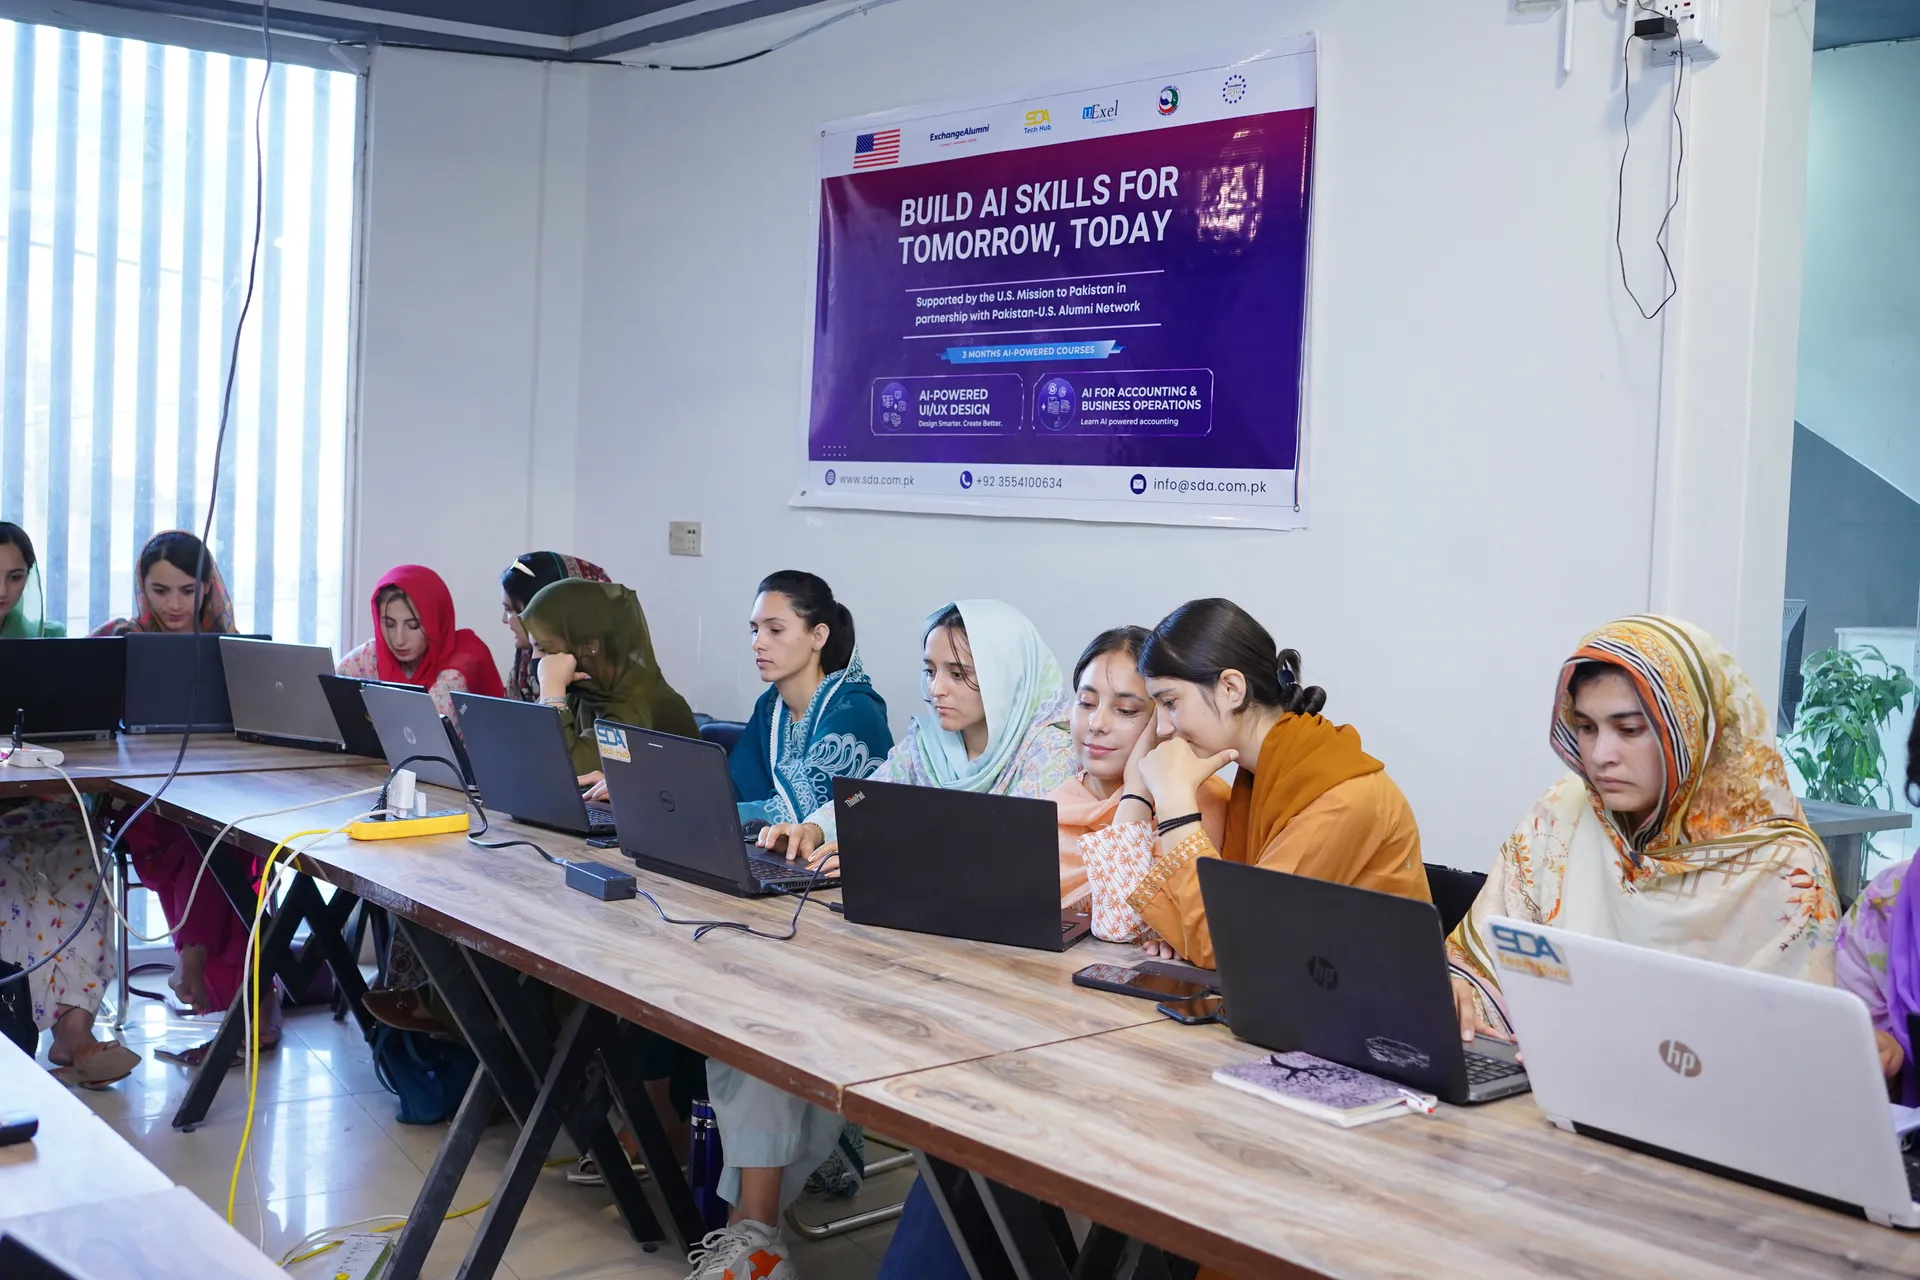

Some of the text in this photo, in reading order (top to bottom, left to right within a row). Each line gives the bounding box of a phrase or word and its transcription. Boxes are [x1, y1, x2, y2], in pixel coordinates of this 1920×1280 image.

[1024, 109, 1052, 126] SDA
[1082, 99, 1119, 120] uExel
[929, 124, 990, 141] ExchangeAlumni
[1024, 126, 1038, 134] Tech
[900, 165, 1179, 227] BUILD AI SKILLS FOR
[898, 209, 1173, 265] TOMORROW, TODAY
[916, 282, 1127, 308] Supported by the U.S. Mission to Pakistan in
[915, 300, 1141, 327] partnership with Pakistan-U.S. Alumni Network
[961, 345, 1095, 359] 3 MONTHS AI-POWERED COURSES
[919, 388, 988, 402] AI-POWERED
[1081, 386, 1198, 398] AI FOR ACCOUNTING &
[919, 403, 990, 417] UI/UX DESIGN
[1081, 399, 1202, 411] BUSINESS OPERATIONS
[918, 420, 938, 429] Design
[1080, 418, 1099, 426] Learn
[1108, 418, 1138, 427] powered
[1139, 417, 1179, 427] accounting
[839, 474, 915, 488] www.sda.com.pk
[976, 476, 1063, 489] +92 3554100634
[1153, 478, 1267, 496] info@sda.com.pk
[596, 725, 627, 749] SDA
[1492, 924, 1562, 964] SDA
[1312, 955, 1336, 990] hp
[1664, 1039, 1698, 1078] hp
